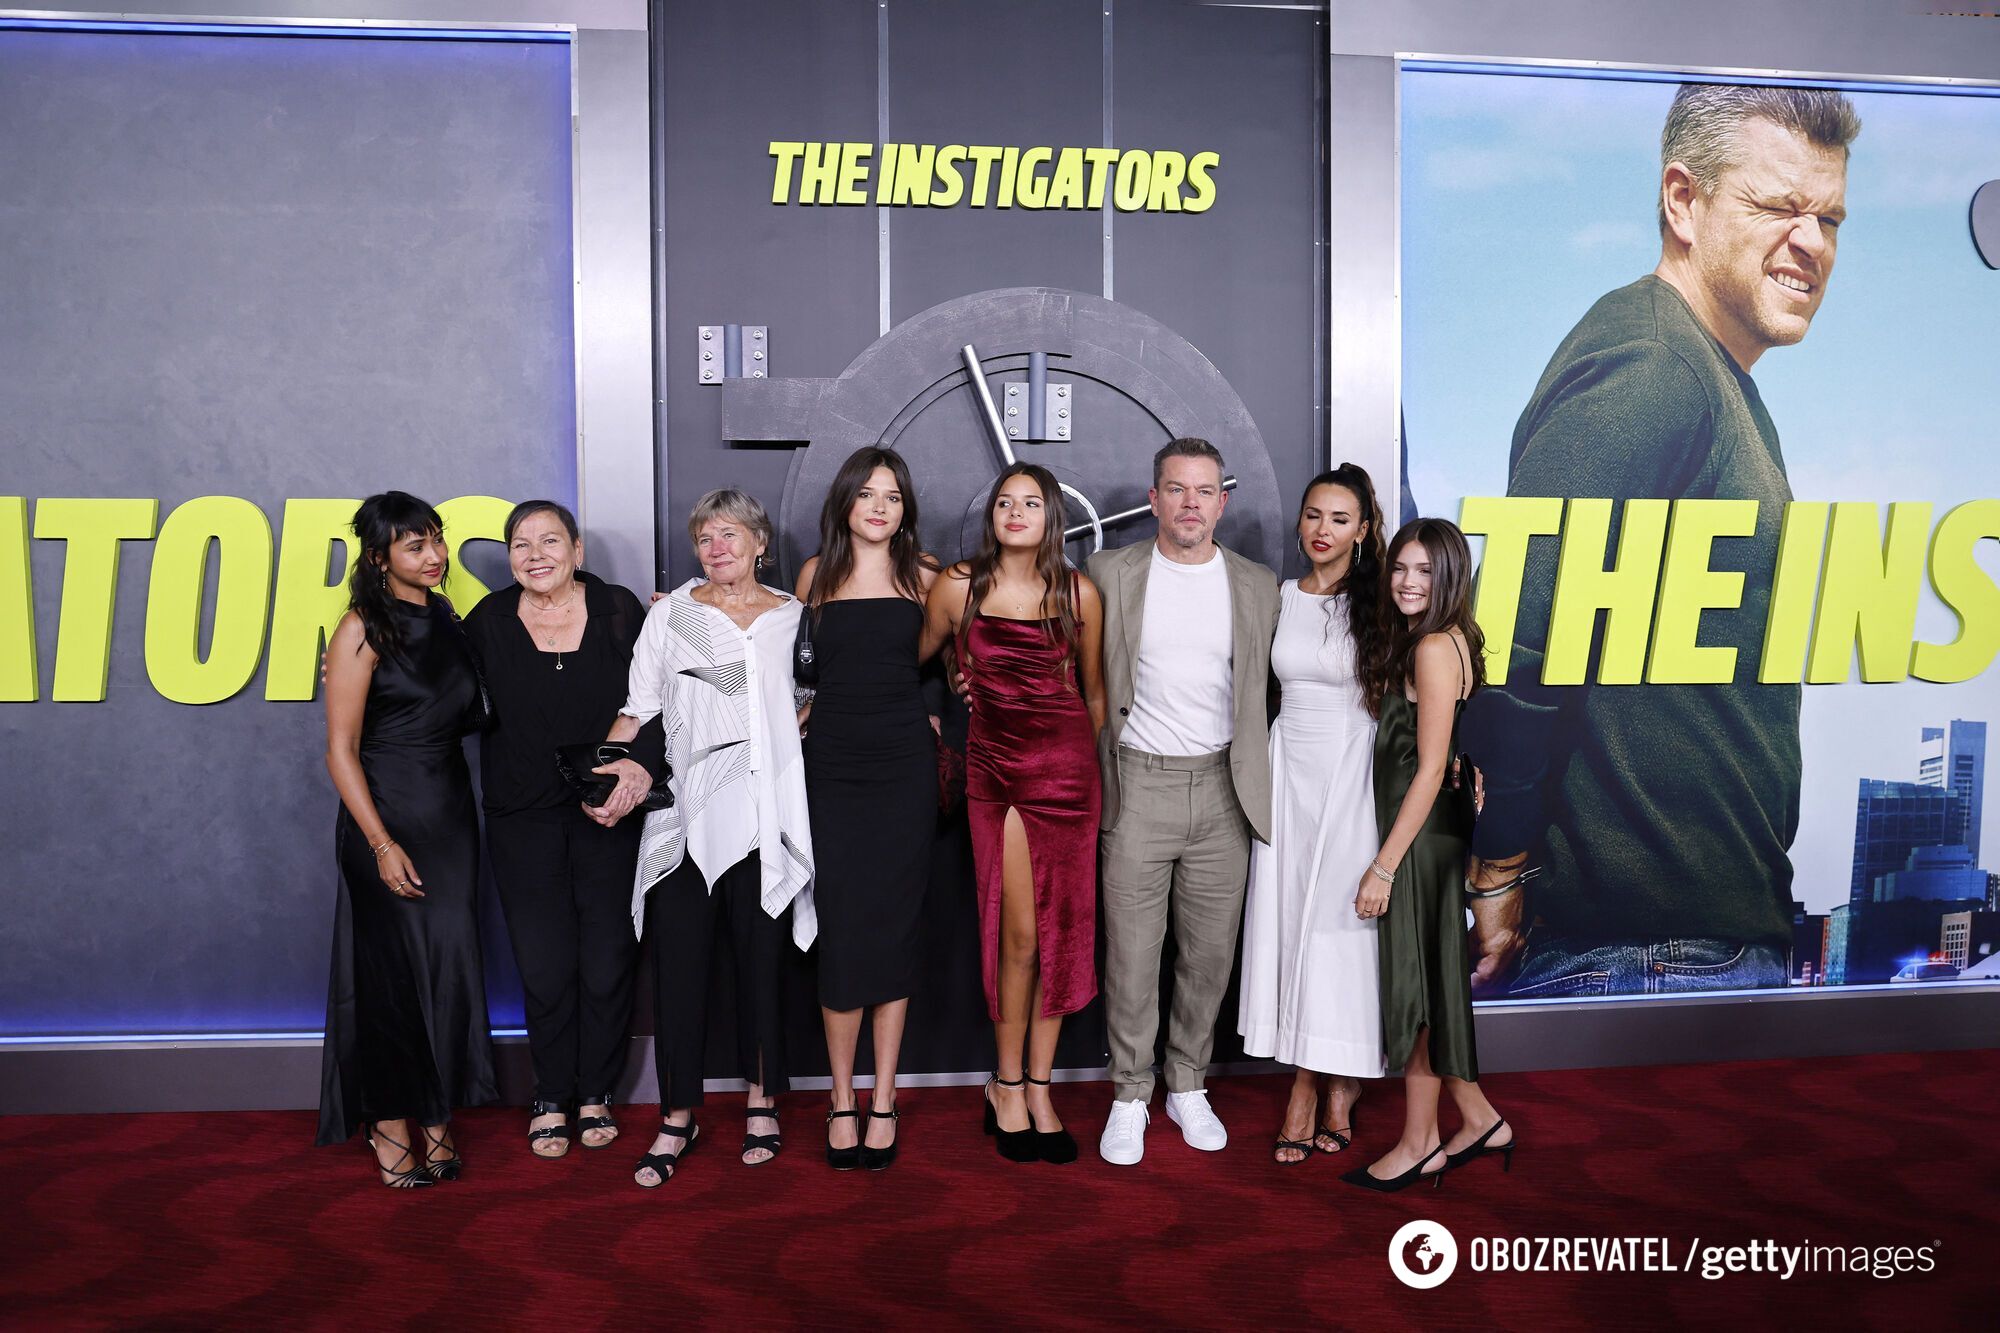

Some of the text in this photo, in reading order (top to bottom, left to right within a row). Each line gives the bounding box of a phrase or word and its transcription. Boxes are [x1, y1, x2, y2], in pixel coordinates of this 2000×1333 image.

[769, 141, 1221, 213] THE INSTIGATORS
[1460, 496, 1761, 686] THE
